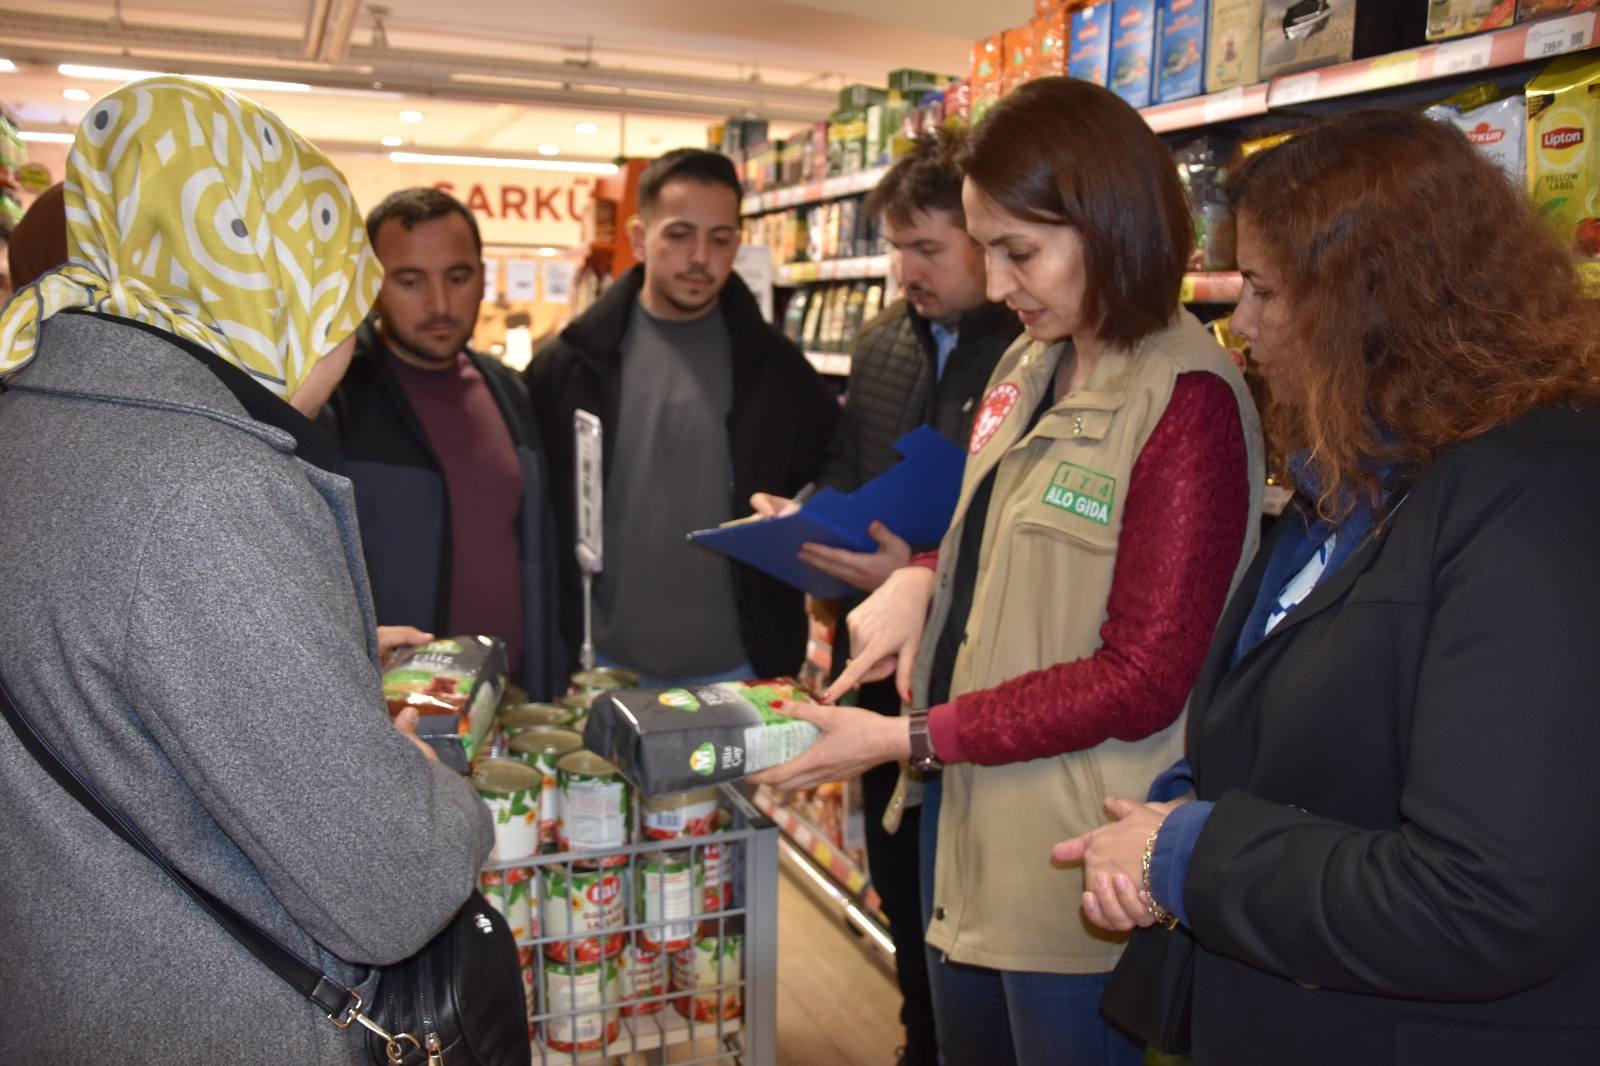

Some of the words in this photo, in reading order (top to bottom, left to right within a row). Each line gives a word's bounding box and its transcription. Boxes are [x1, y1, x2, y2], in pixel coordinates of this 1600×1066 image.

[1545, 131, 1580, 147] Lipton
[1546, 172, 1579, 183] YELLOW
[1549, 181, 1575, 192] LABEL
[1045, 486, 1074, 508] ALO
[1075, 496, 1108, 523] GIDA
